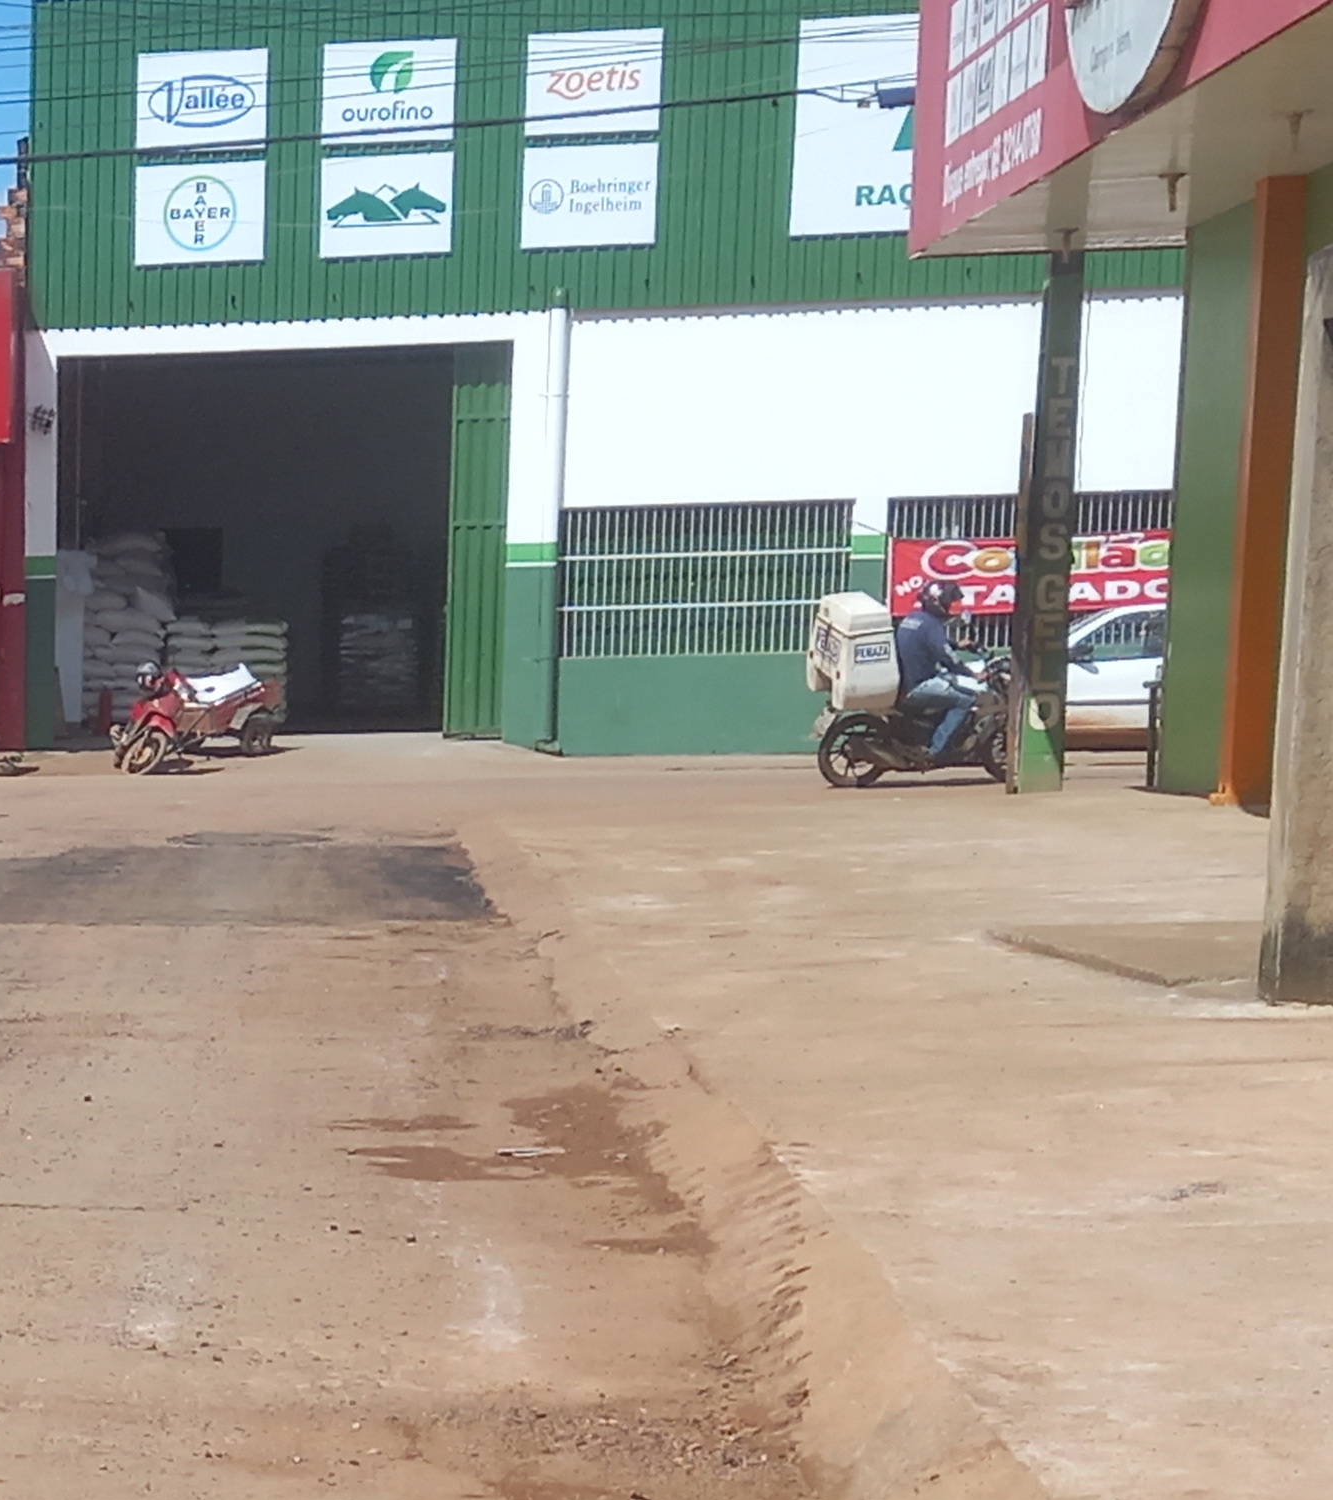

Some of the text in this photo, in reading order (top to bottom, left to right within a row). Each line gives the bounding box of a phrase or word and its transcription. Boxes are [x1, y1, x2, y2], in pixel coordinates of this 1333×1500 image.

[546, 64, 642, 101] zoetis
[166, 80, 246, 124] Vallée
[341, 102, 434, 122] ourofino
[568, 177, 651, 196] Boehringer
[170, 206, 231, 220] BAYER
[568, 194, 643, 215] Ingelheim
[1027, 573, 1066, 731] GELO
